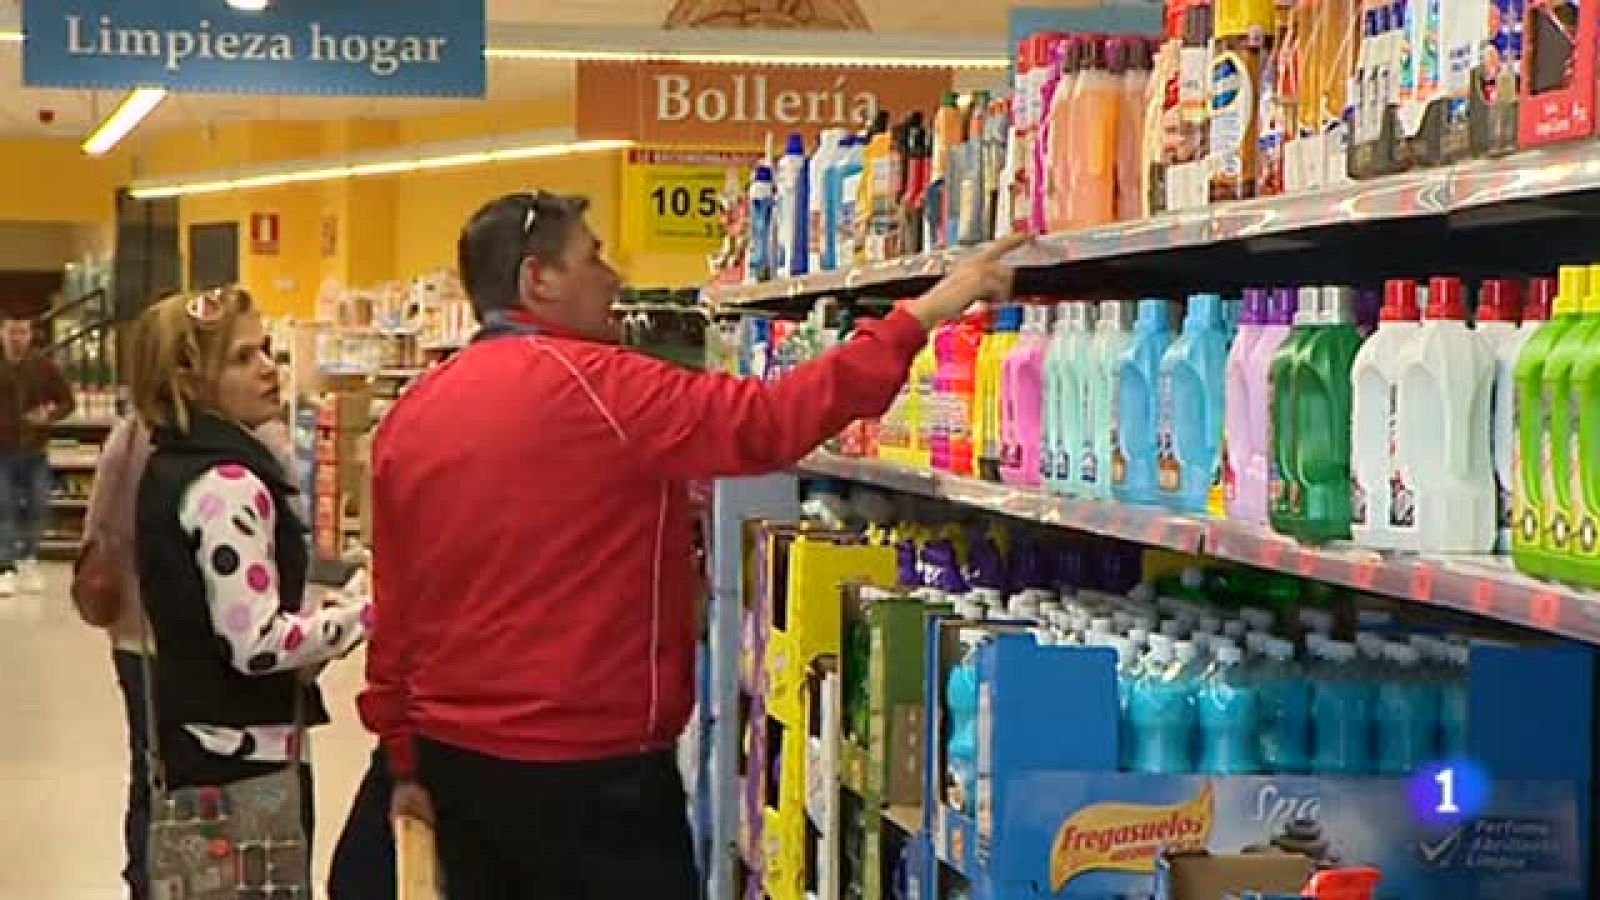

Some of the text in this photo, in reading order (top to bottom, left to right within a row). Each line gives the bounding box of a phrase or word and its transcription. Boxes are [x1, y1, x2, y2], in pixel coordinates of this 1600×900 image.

[65, 14, 448, 76] Limpieza hogar
[654, 74, 879, 123] Bollería
